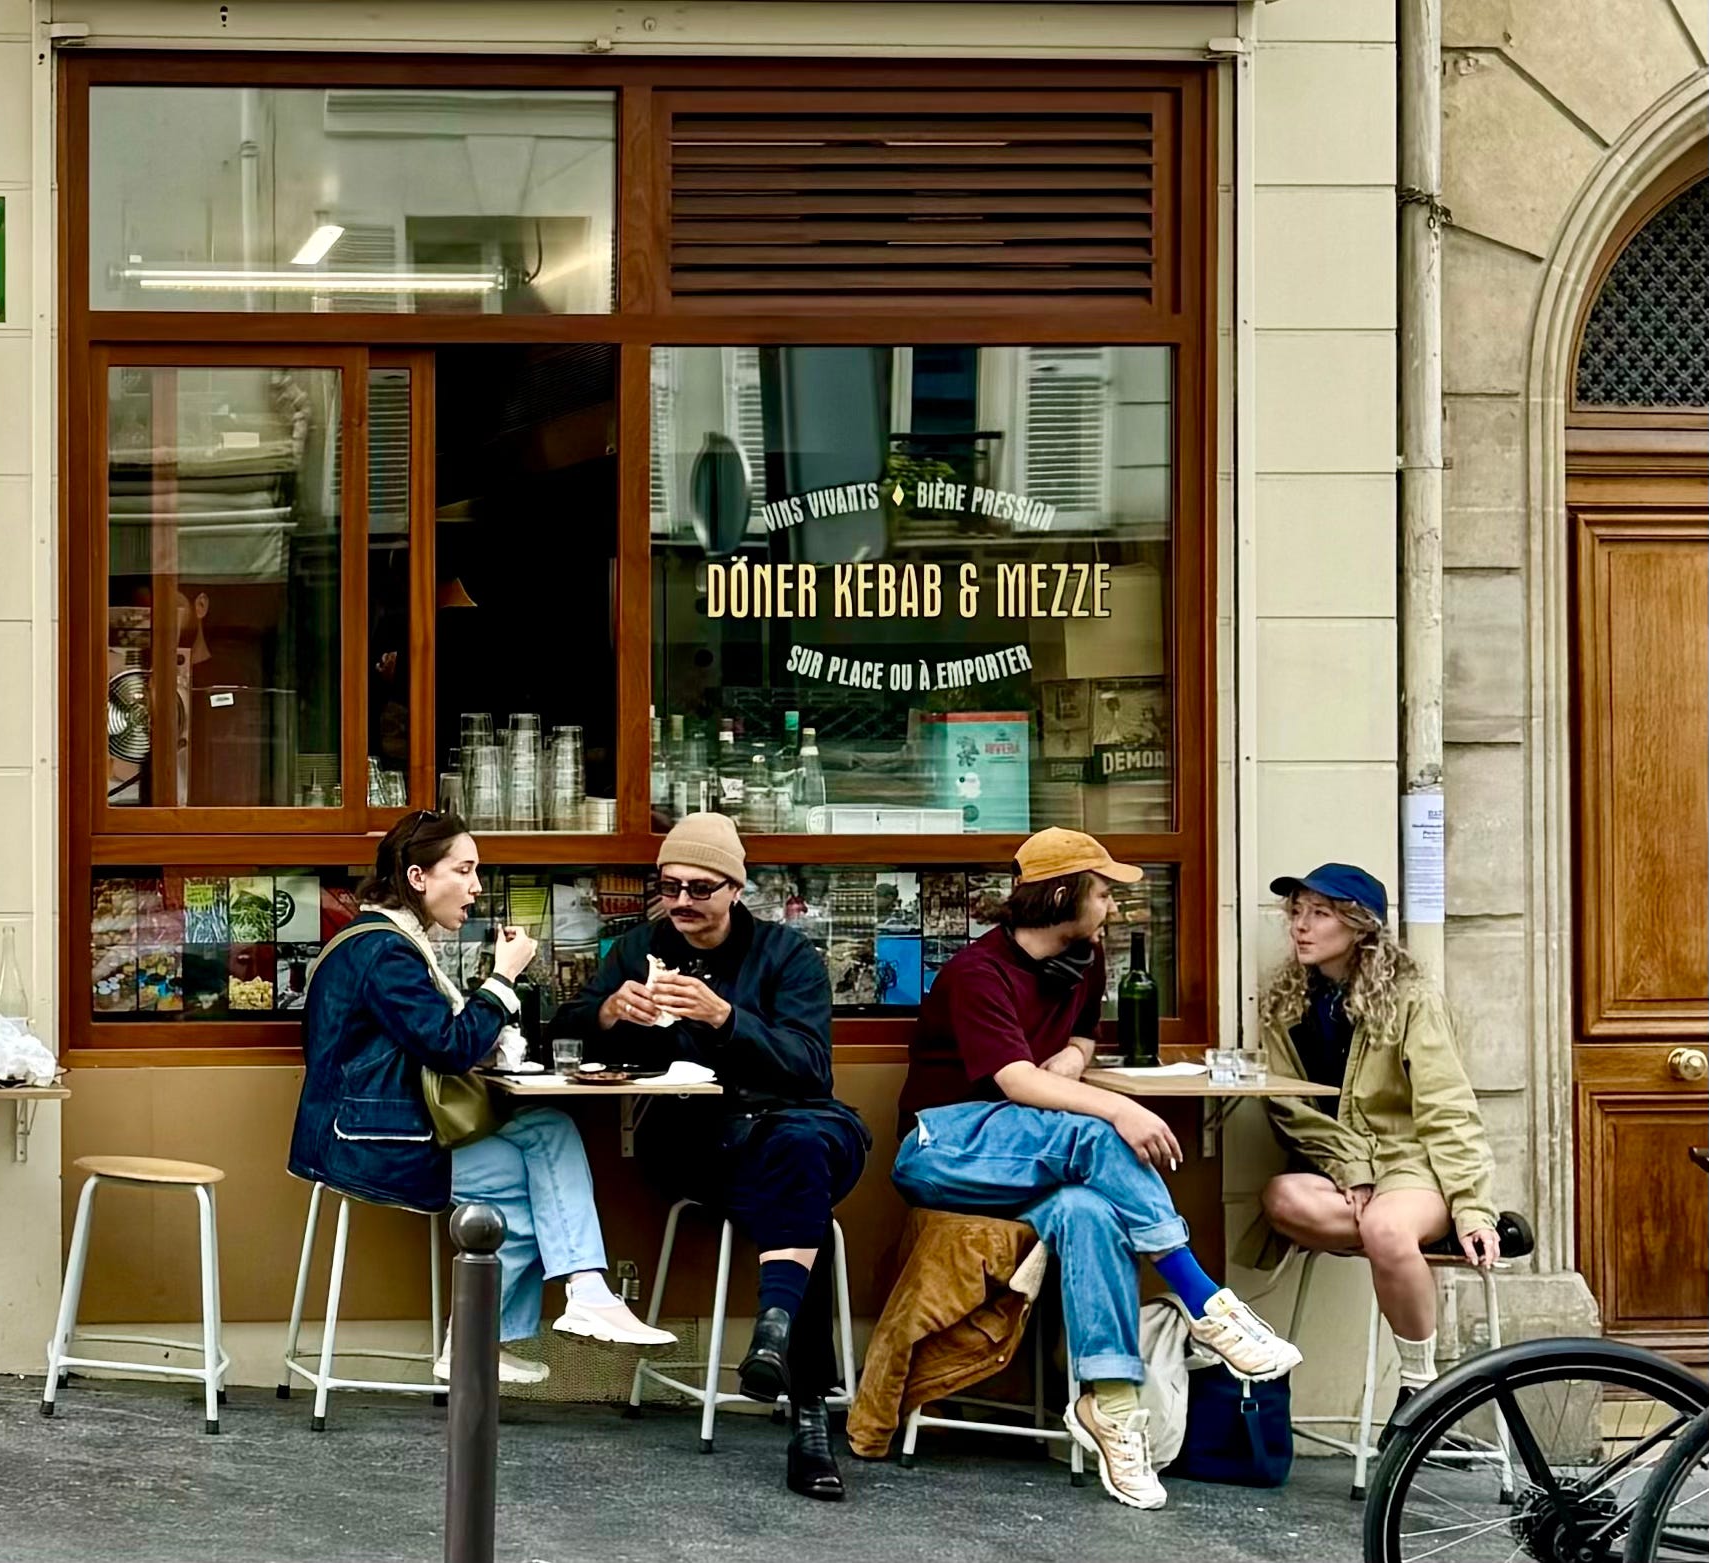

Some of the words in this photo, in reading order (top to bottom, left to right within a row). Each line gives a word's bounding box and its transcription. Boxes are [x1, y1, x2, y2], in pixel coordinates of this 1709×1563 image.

[760, 496, 805, 532] VINS
[806, 482, 880, 519] VIVANTS
[916, 477, 967, 512] BIÈRE
[970, 486, 1057, 532] PRESSION
[707, 555, 817, 618] DÖNER
[834, 563, 942, 618] KEBAB
[959, 562, 980, 618] &
[997, 563, 1111, 618] MEZZE
[786, 644, 824, 679] SUR
[826, 656, 884, 690] PLACE
[889, 663, 913, 691] OU
[918, 659, 931, 691] À
[936, 644, 1033, 690] EMPORTER
[1102, 750, 1171, 775] DEMOR
